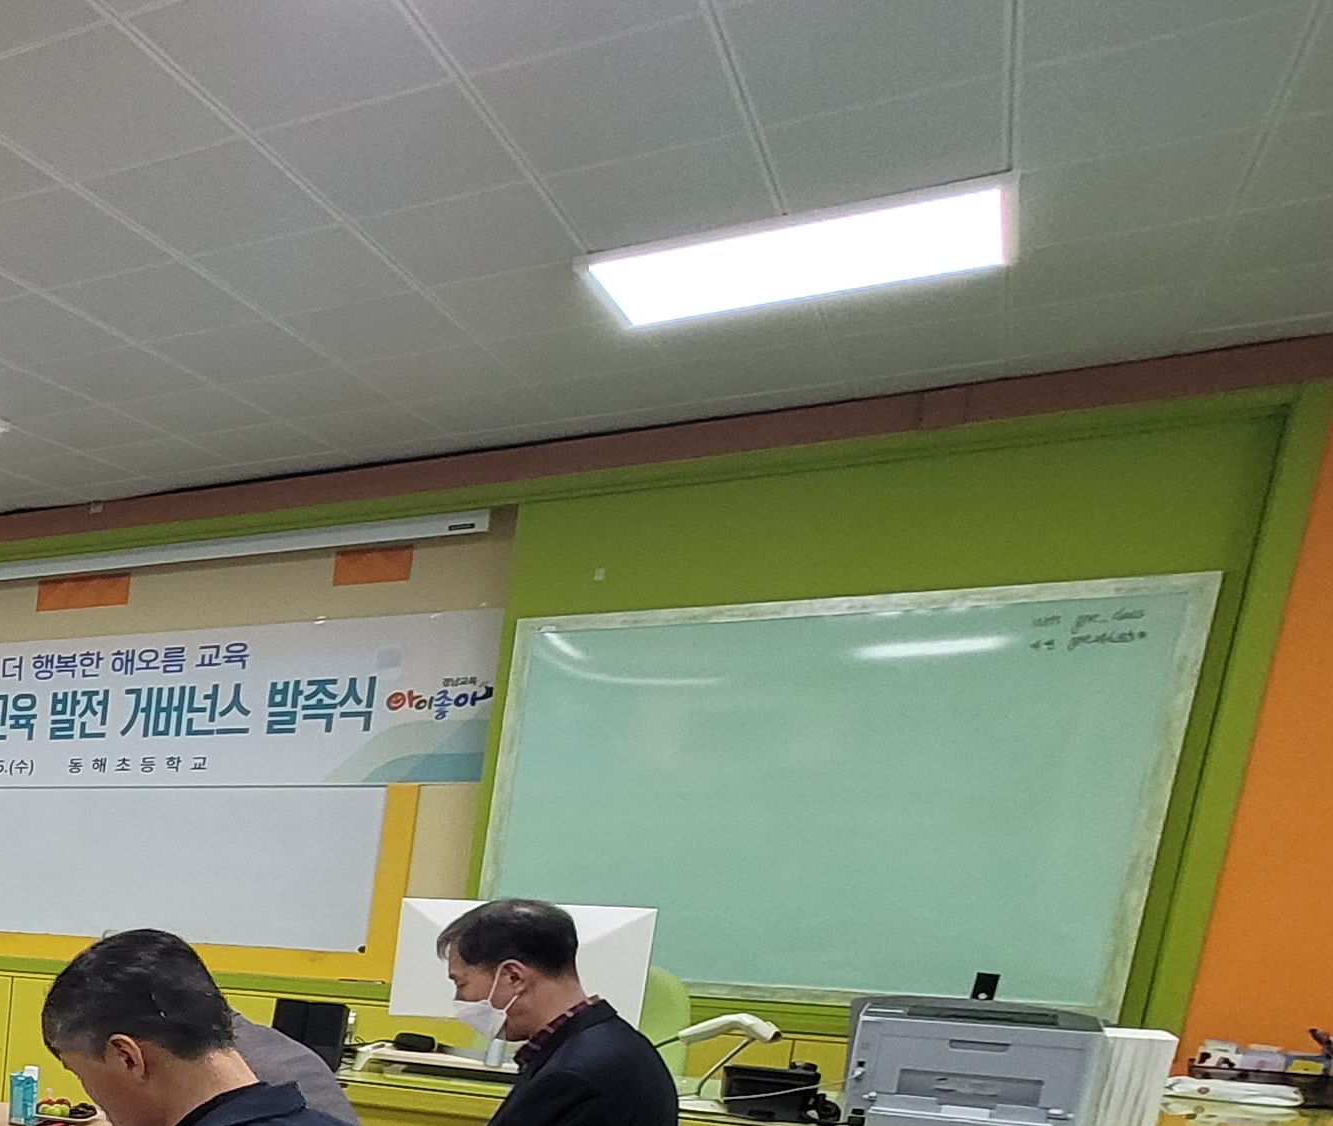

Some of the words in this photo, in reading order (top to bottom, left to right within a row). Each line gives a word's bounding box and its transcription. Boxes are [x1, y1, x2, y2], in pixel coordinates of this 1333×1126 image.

[2, 656, 23, 681] 더
[32, 651, 104, 680] 행복한
[111, 646, 186, 675] 해오름
[195, 642, 250, 669] 교육
[49, 688, 110, 740] 발전
[120, 682, 251, 739] 거버넌스
[265, 675, 377, 735] 발족식
[386, 685, 493, 721] 아이좋아
